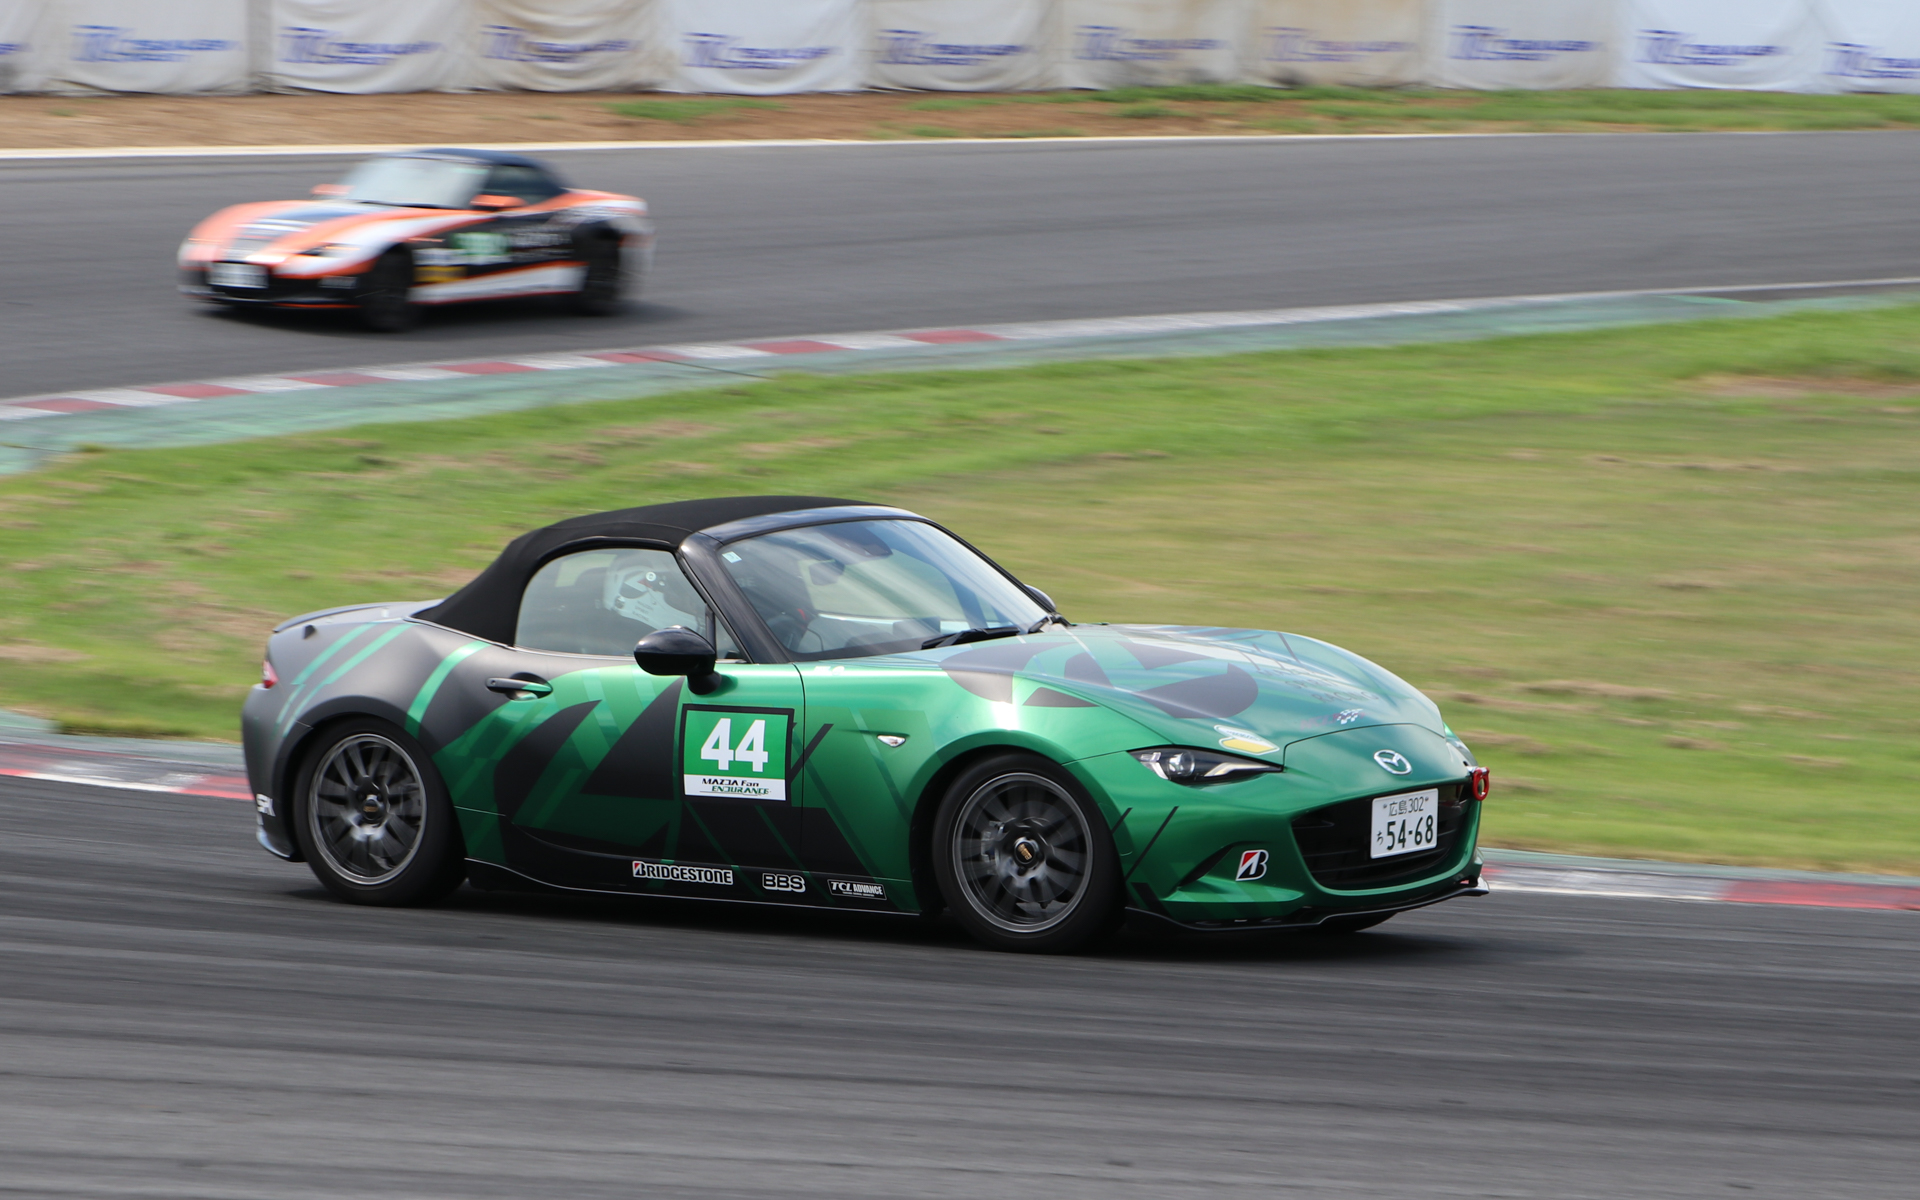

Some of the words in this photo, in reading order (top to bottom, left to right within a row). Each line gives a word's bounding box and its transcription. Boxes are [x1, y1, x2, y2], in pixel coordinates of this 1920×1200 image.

[701, 718, 768, 772] 44
[712, 785, 770, 795] ENDURANCE
[1387, 815, 1434, 850] 54-68
[632, 861, 733, 886] BRIDGESTONE
[762, 873, 806, 893] BBS
[831, 882, 852, 891] TCL
[853, 883, 883, 895] ADVANCE
